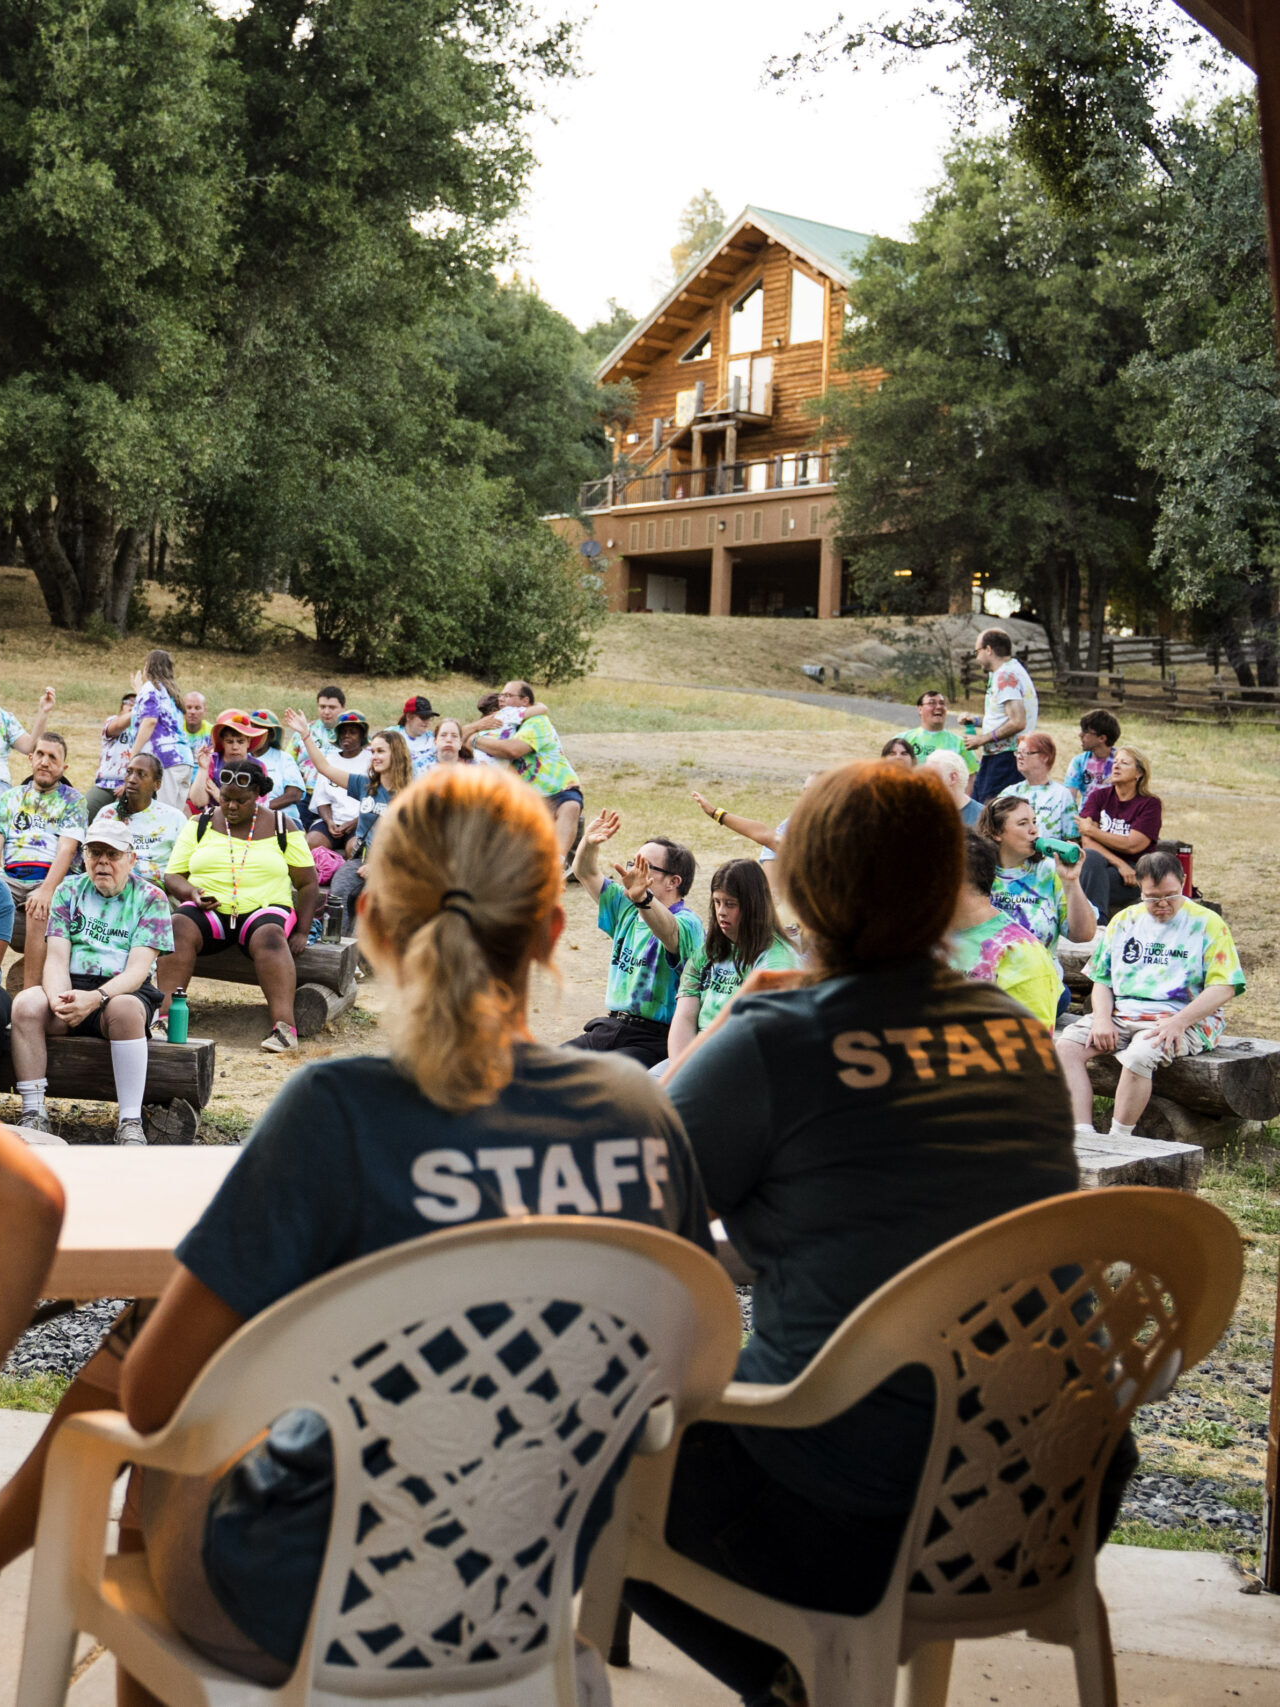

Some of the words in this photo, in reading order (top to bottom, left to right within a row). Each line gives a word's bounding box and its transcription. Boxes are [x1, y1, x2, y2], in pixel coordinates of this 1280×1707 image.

[87, 920, 129, 938] TUOLUMNE
[89, 916, 109, 928] camp
[85, 928, 110, 944] TRAILS
[1142, 956, 1169, 965] TRAILS
[1144, 947, 1189, 959] TUOLUMNE
[831, 1018, 1057, 1090] STAFF
[409, 1137, 669, 1223] STAFF
